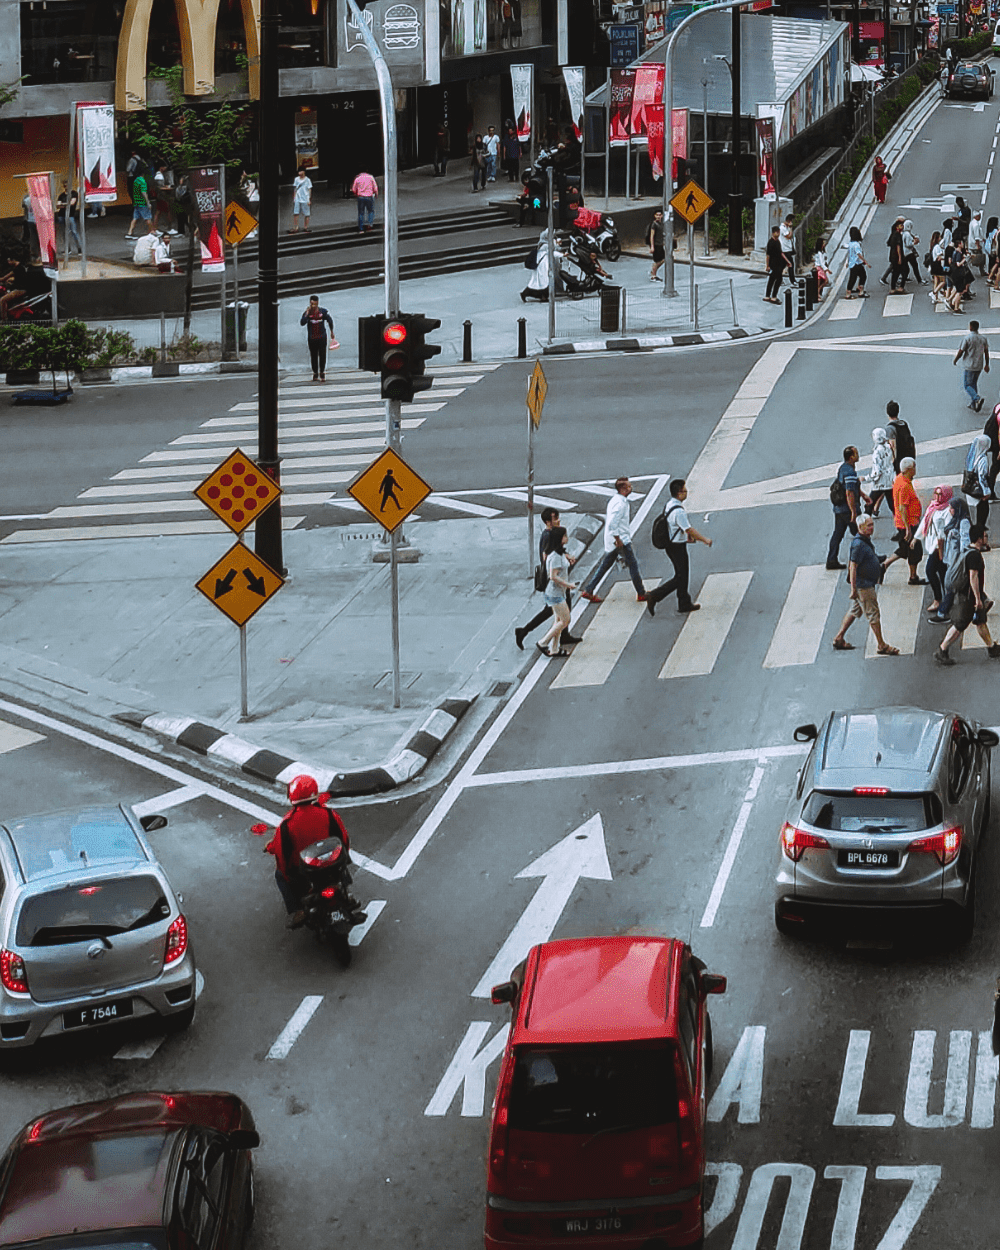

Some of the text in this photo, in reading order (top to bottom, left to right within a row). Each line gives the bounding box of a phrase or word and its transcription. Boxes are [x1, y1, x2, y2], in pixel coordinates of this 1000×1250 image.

[343, 100, 355, 110] 24
[848, 852, 865, 863] BPL
[80, 1005, 117, 1023] F 7544
[565, 1217, 622, 1232] WRJ 3176
